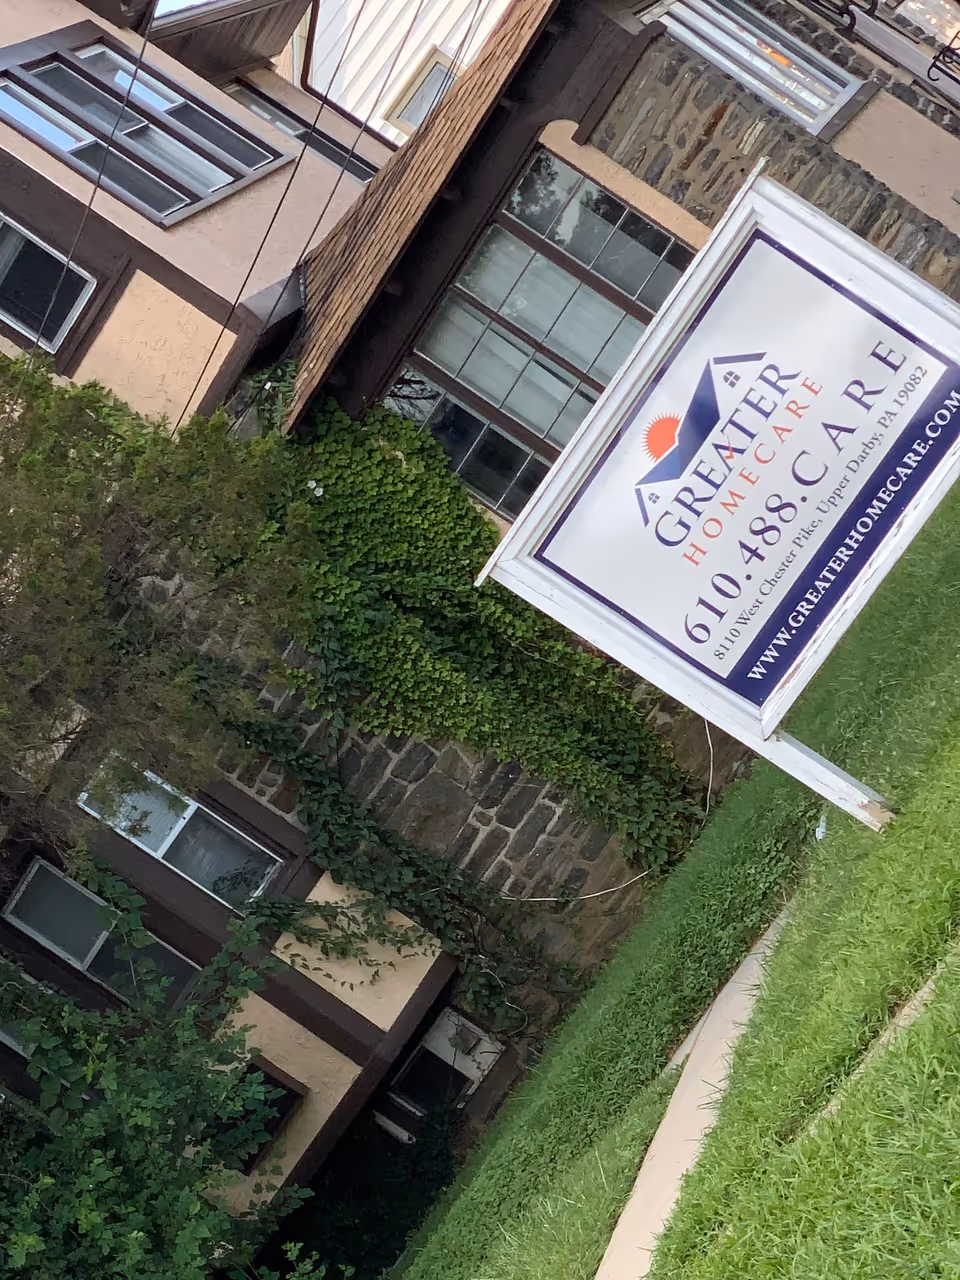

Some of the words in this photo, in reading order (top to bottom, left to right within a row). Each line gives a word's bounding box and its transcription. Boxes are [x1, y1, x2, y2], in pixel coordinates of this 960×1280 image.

[654, 363, 802, 547] GREATER
[682, 376, 823, 567] HOMECARE
[684, 340, 908, 644] 610.488.CARE
[713, 627, 741, 660] 8110
[734, 597, 763, 628] West
[759, 550, 797, 596] Chester
[792, 519, 823, 549] Pike,
[815, 474, 851, 514] Upper
[844, 431, 884, 474] Darby,
[876, 409, 898, 430] PA
[892, 365, 928, 409] 19082
